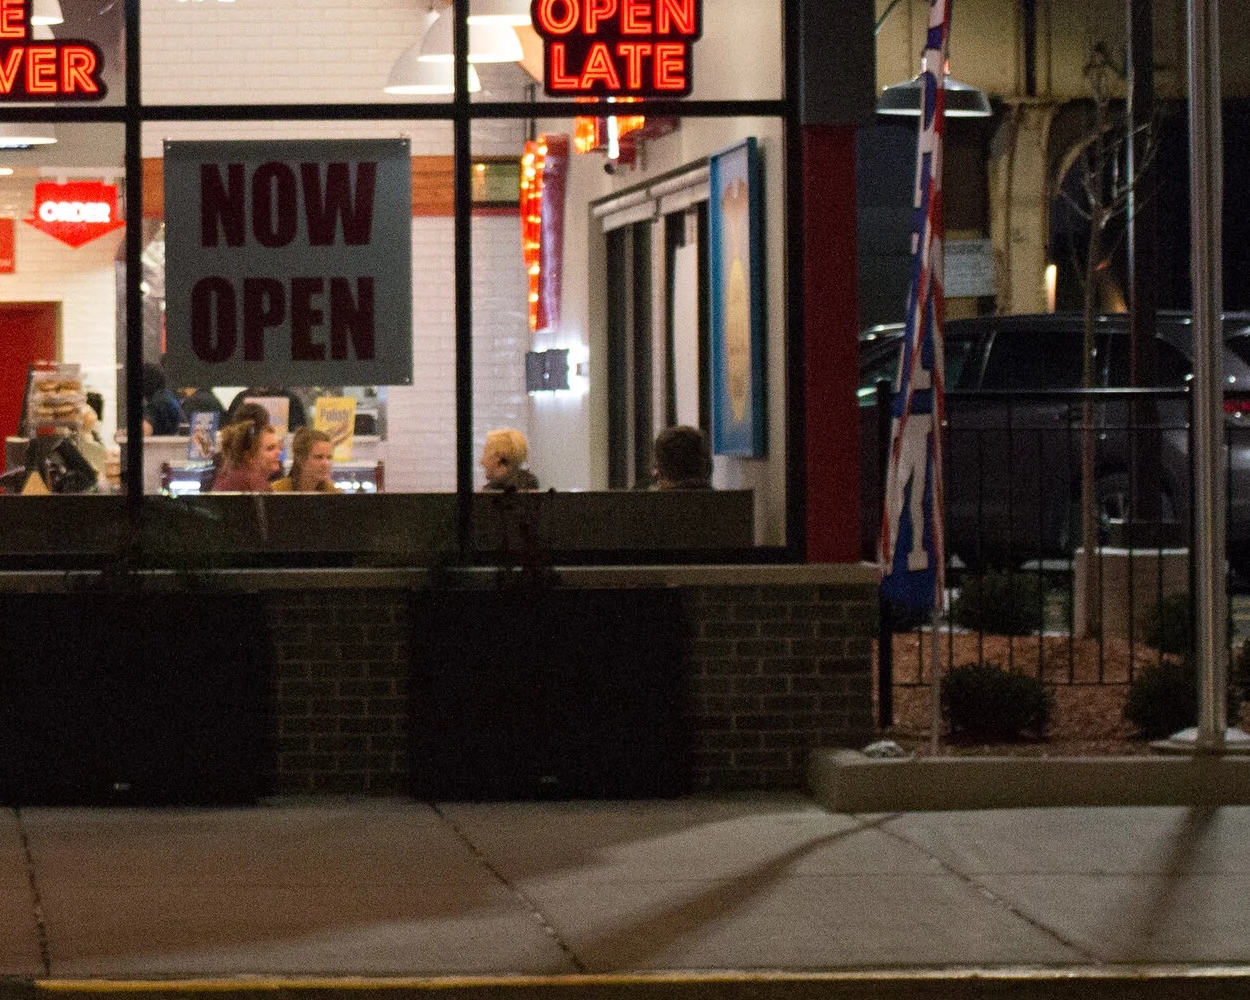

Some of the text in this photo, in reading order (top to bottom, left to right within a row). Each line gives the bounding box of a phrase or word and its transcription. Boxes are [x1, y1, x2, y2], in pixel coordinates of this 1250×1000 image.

[551, 42, 686, 91] LATE
[39, 201, 111, 223] ORDER
[200, 160, 377, 248] NOW
[190, 275, 376, 363] OPEN
